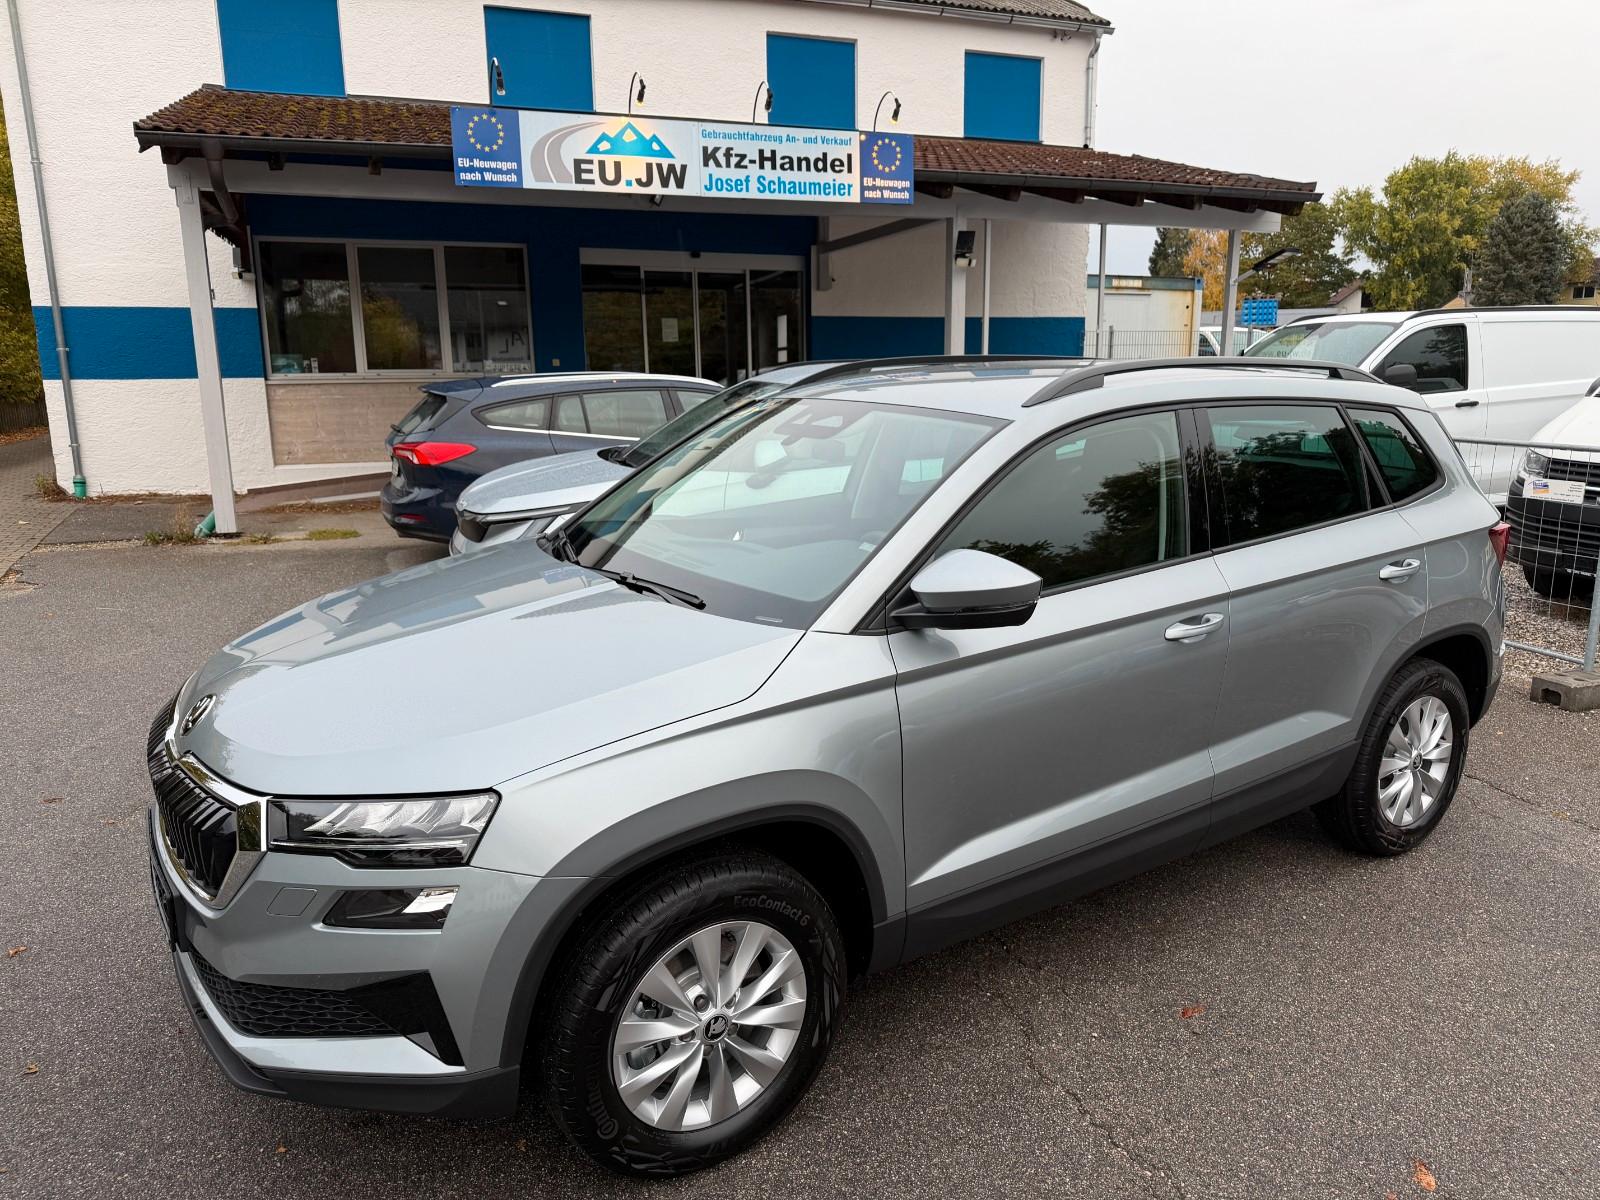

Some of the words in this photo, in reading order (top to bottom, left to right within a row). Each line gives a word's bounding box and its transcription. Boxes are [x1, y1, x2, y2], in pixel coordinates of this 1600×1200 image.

[701, 129, 783, 144] Gebrauchtfahrzeug
[785, 133, 800, 144] An-
[802, 135, 818, 145] und
[820, 136, 852, 146] Verkauf
[458, 157, 518, 170] EU-Neuwagen
[702, 145, 853, 174] Kfz-Handel
[460, 171, 481, 181] nach
[483, 171, 517, 182] Wunsch
[573, 158, 688, 190] EU.JW
[703, 173, 750, 192] Josef
[756, 175, 853, 197] Schaumeier
[863, 177, 910, 189] EU-Neuwagen
[864, 189, 881, 198] nach
[883, 189, 909, 199] Wunsch
[734, 894, 802, 921] EcoContact
[800, 915, 810, 926] 6
